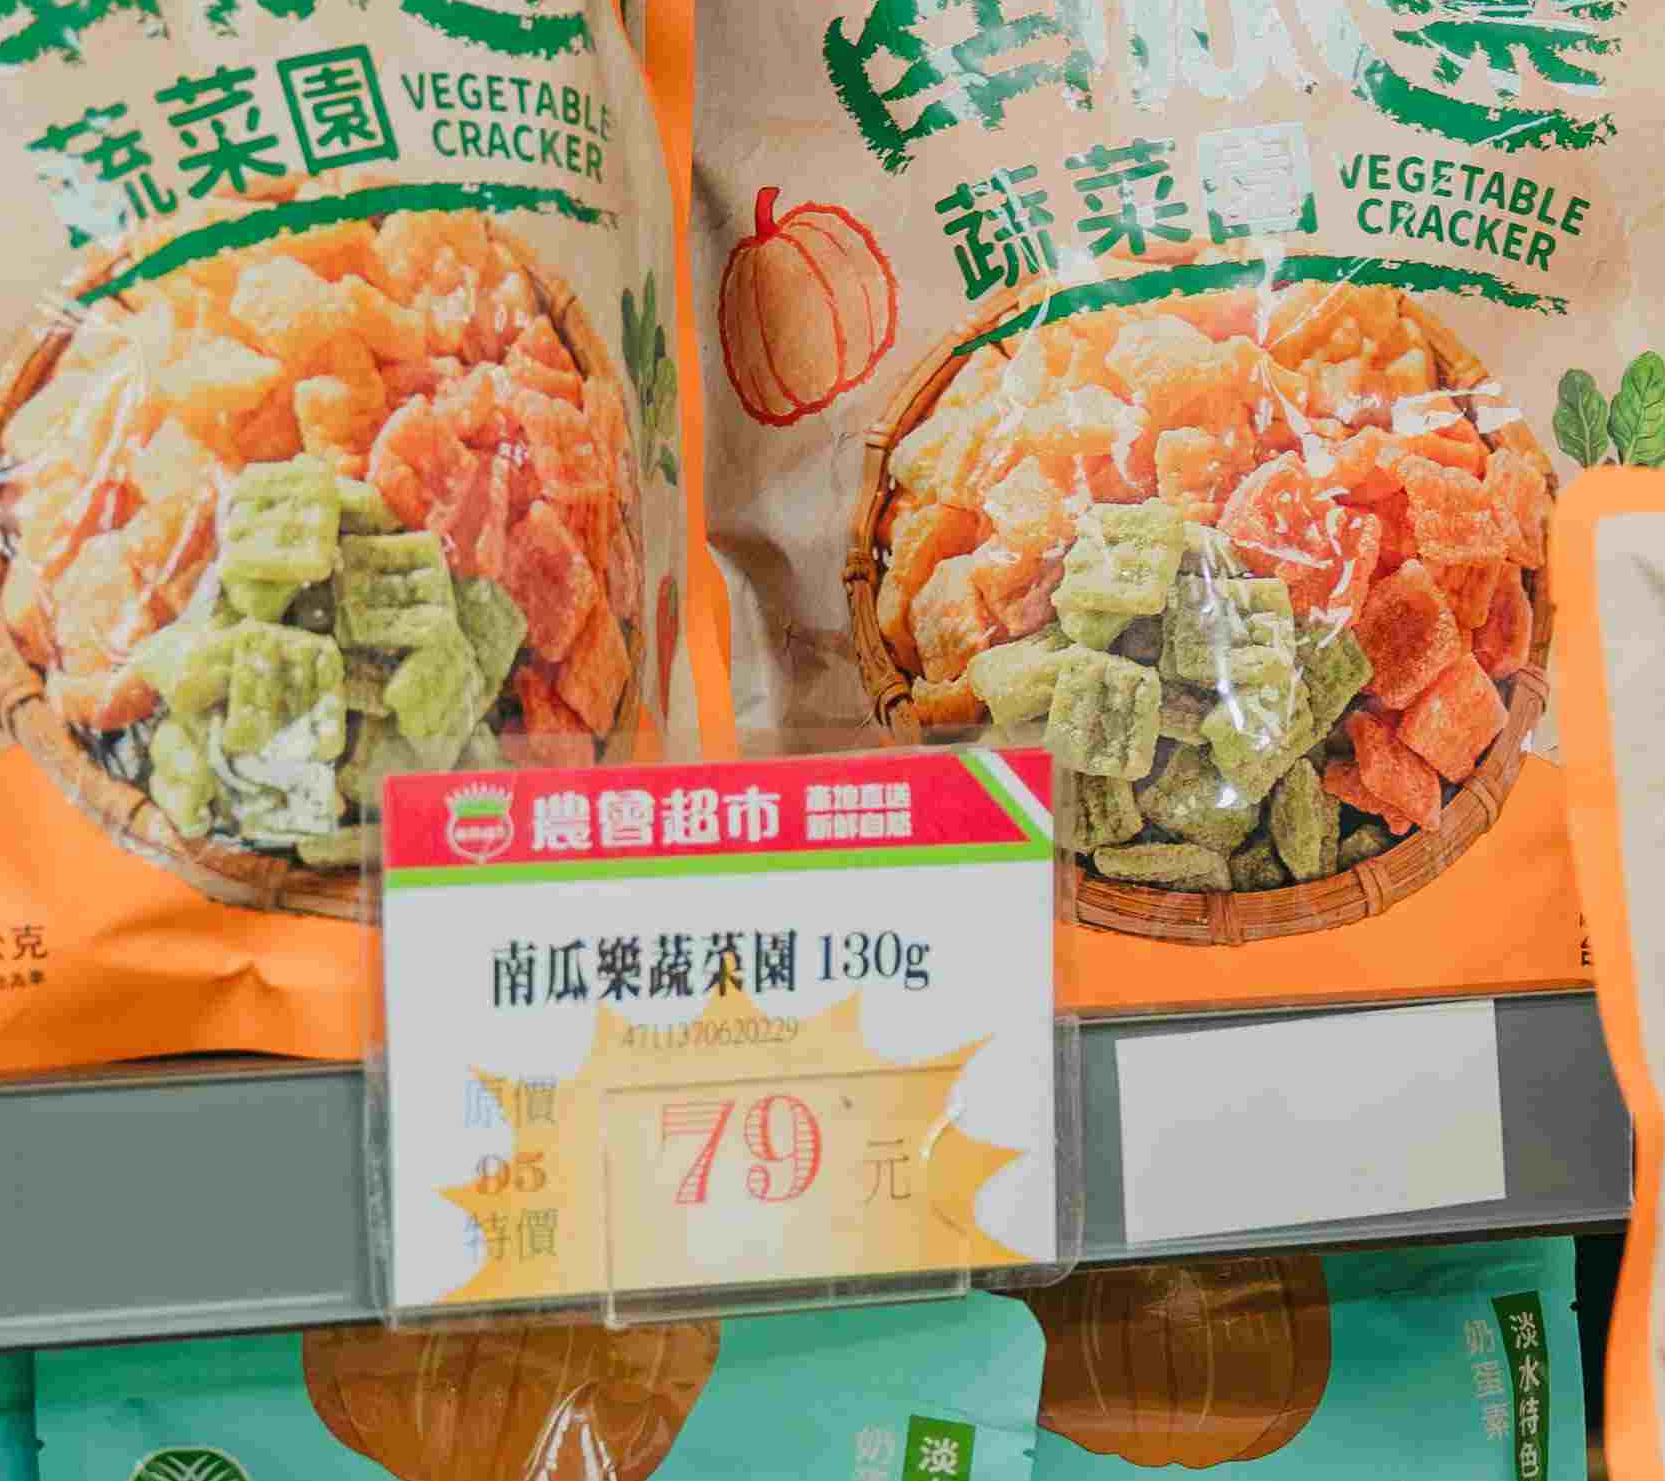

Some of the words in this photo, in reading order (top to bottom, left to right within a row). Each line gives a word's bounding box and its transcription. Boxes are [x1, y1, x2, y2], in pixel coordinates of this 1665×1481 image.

[400, 68, 616, 144] VEGETABLE
[25, 42, 401, 250] 蔬菜園
[430, 117, 607, 186] CRACKER
[933, 122, 1319, 302] 蔬菜園
[1338, 152, 1592, 240] VEGETABLE
[1355, 196, 1560, 274] CRACKER
[529, 783, 783, 852] 農會超市
[489, 927, 799, 1008] 南瓜樂蔬菜園
[815, 929, 933, 992] 130g
[464, 1073, 558, 1127] 原價
[657, 1092, 823, 1206] 79
[859, 1136, 913, 1202] 元
[462, 1208, 561, 1263] 特價
